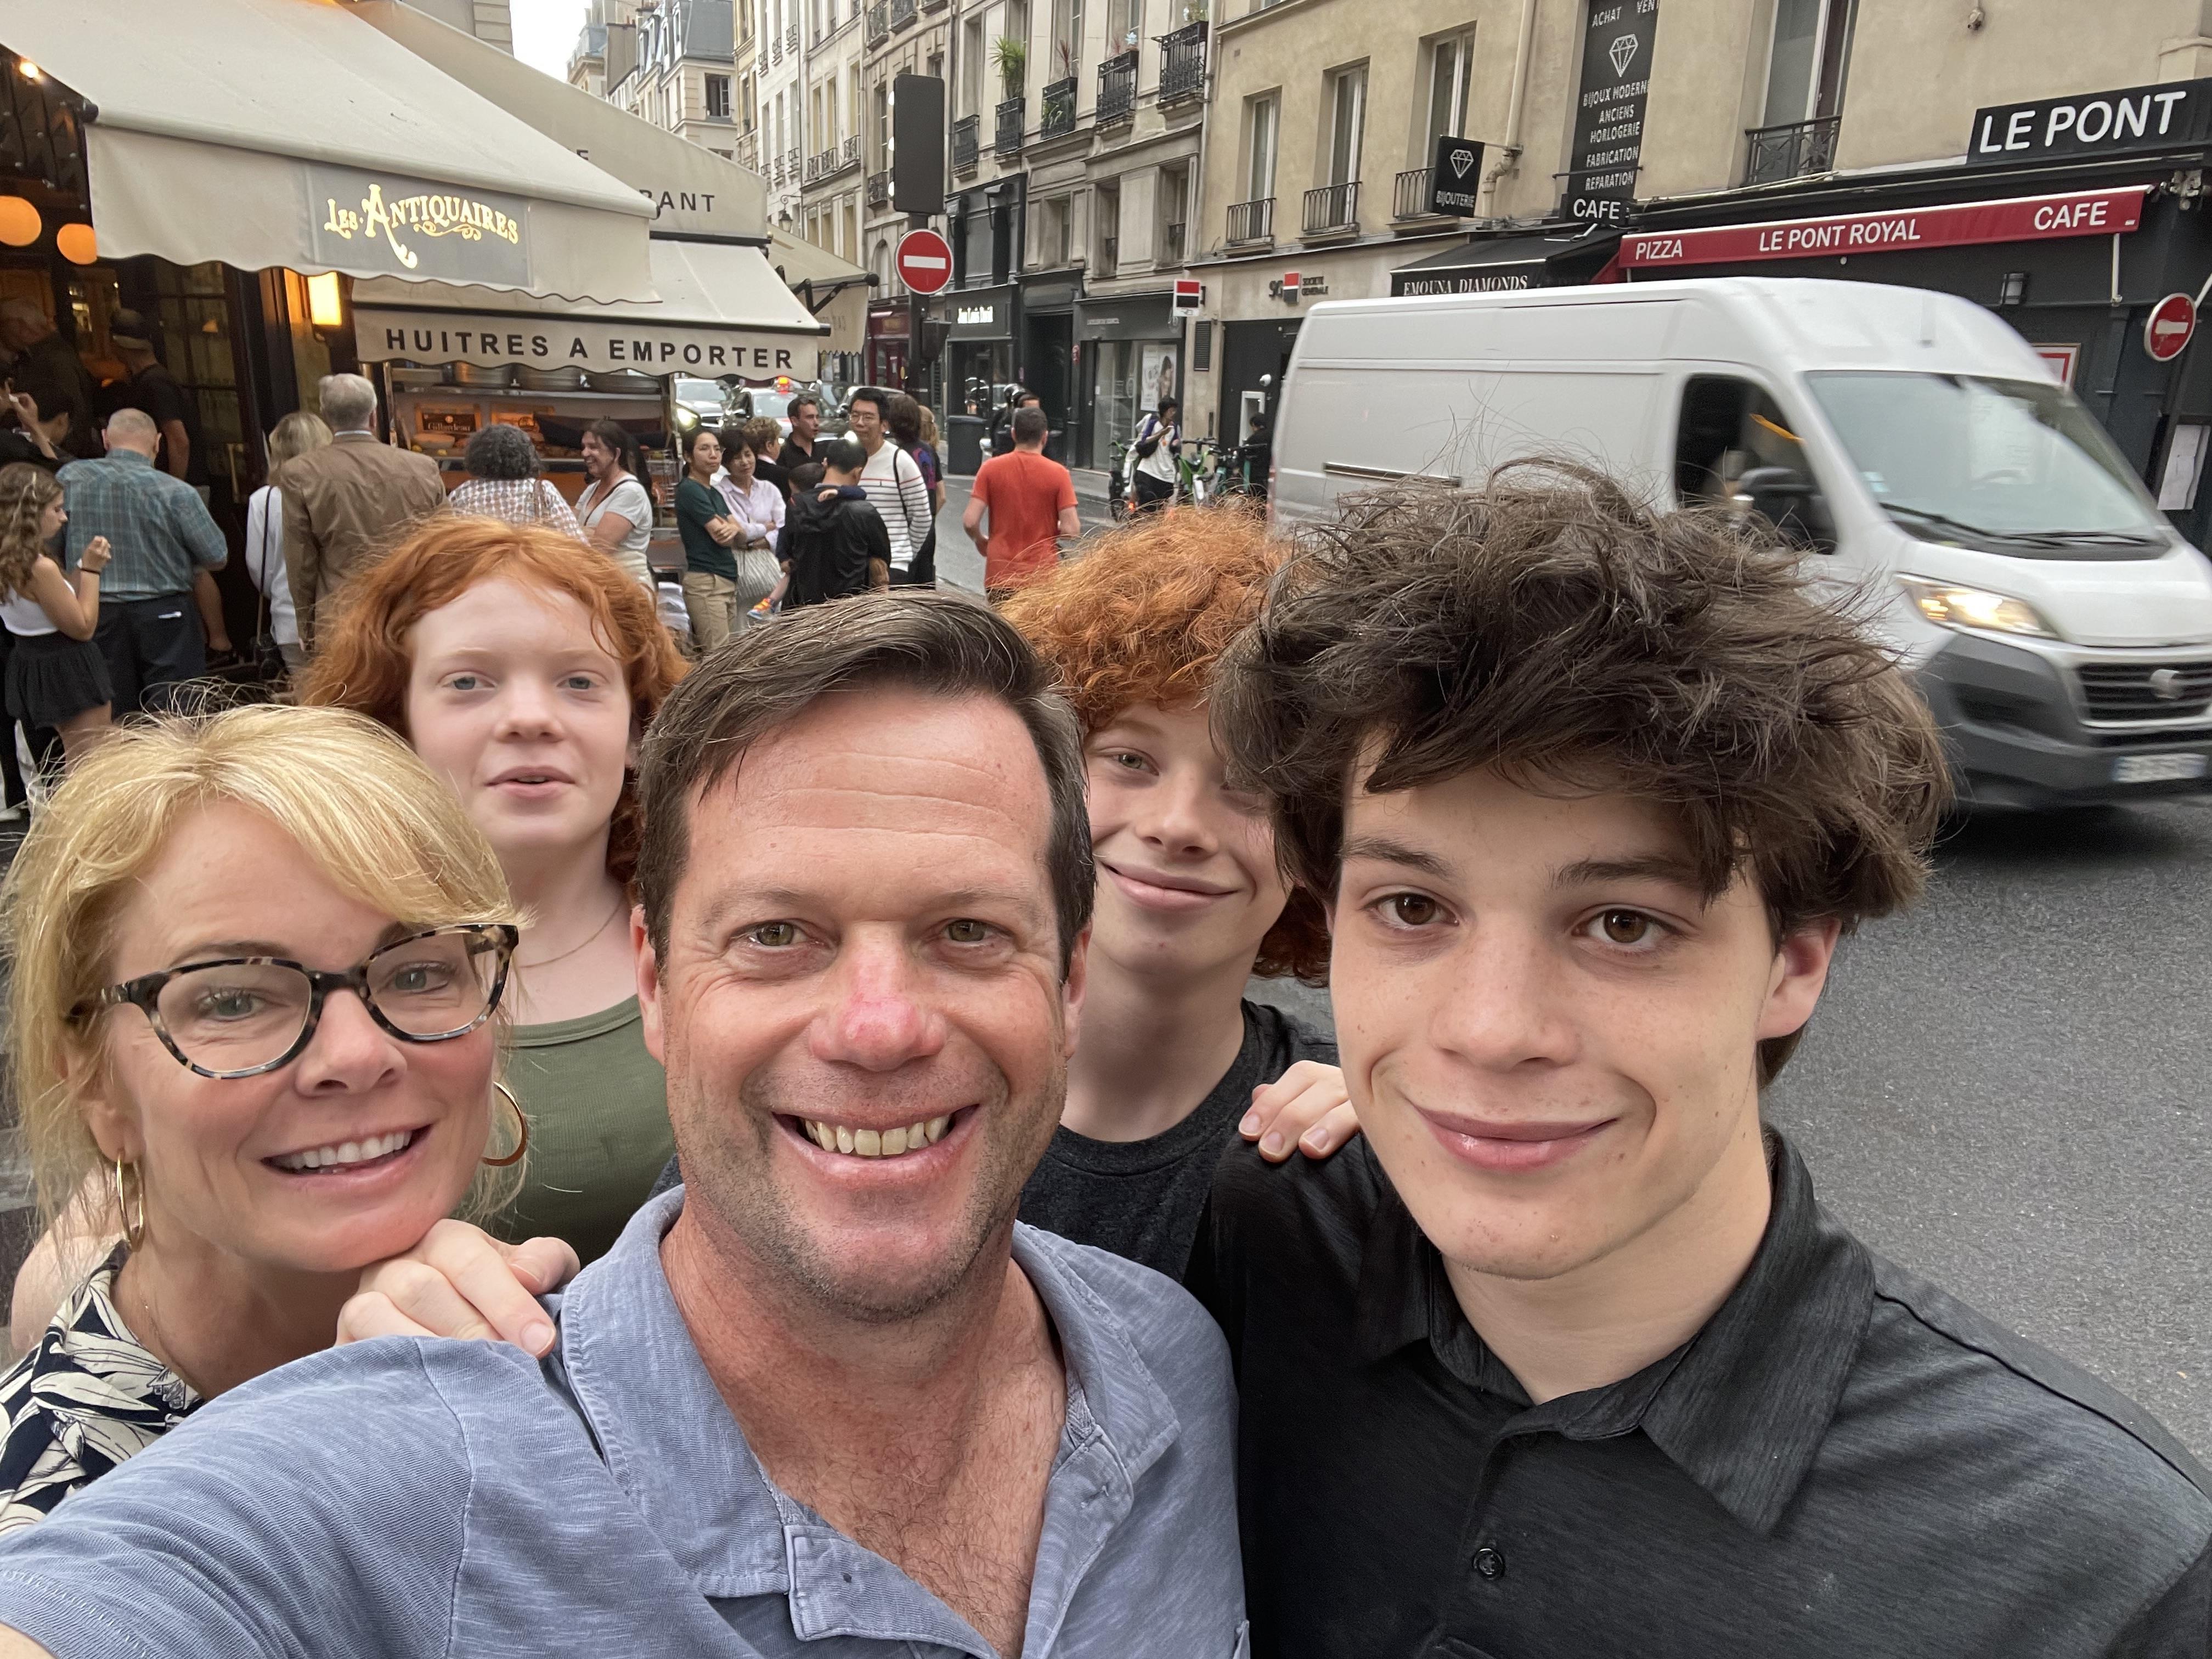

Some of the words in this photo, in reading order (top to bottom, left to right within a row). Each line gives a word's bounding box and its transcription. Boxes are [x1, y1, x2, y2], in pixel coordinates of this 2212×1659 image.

[1592, 7, 1622, 27] ACHAT
[1583, 88, 1611, 108] BIJOUX
[1599, 104, 1634, 124] ANCIENS
[1979, 110, 2036, 153] LE
[2045, 91, 2186, 147] PONT
[1590, 121, 1640, 144] HORLOGERIE
[1586, 145, 1639, 167] FABRICATION
[1585, 171, 1635, 191] REPARATION
[1436, 190, 1475, 207] BIJOUTERIE
[1573, 199, 1621, 219] CAFE
[361, 184, 518, 269] ANTIQUAIRES
[1635, 239, 1683, 260] PIZZA
[1759, 230, 1784, 252] LE
[1788, 225, 1846, 250] PONT
[1849, 218, 1921, 245] ROYAL
[2034, 201, 2109, 230] CAFE
[1403, 280, 1452, 296] EMOUNA
[1458, 275, 1528, 294] DIAMONDS
[386, 328, 548, 357] HUITRES
[569, 337, 588, 358] A
[609, 339, 792, 369] EMPORTER
